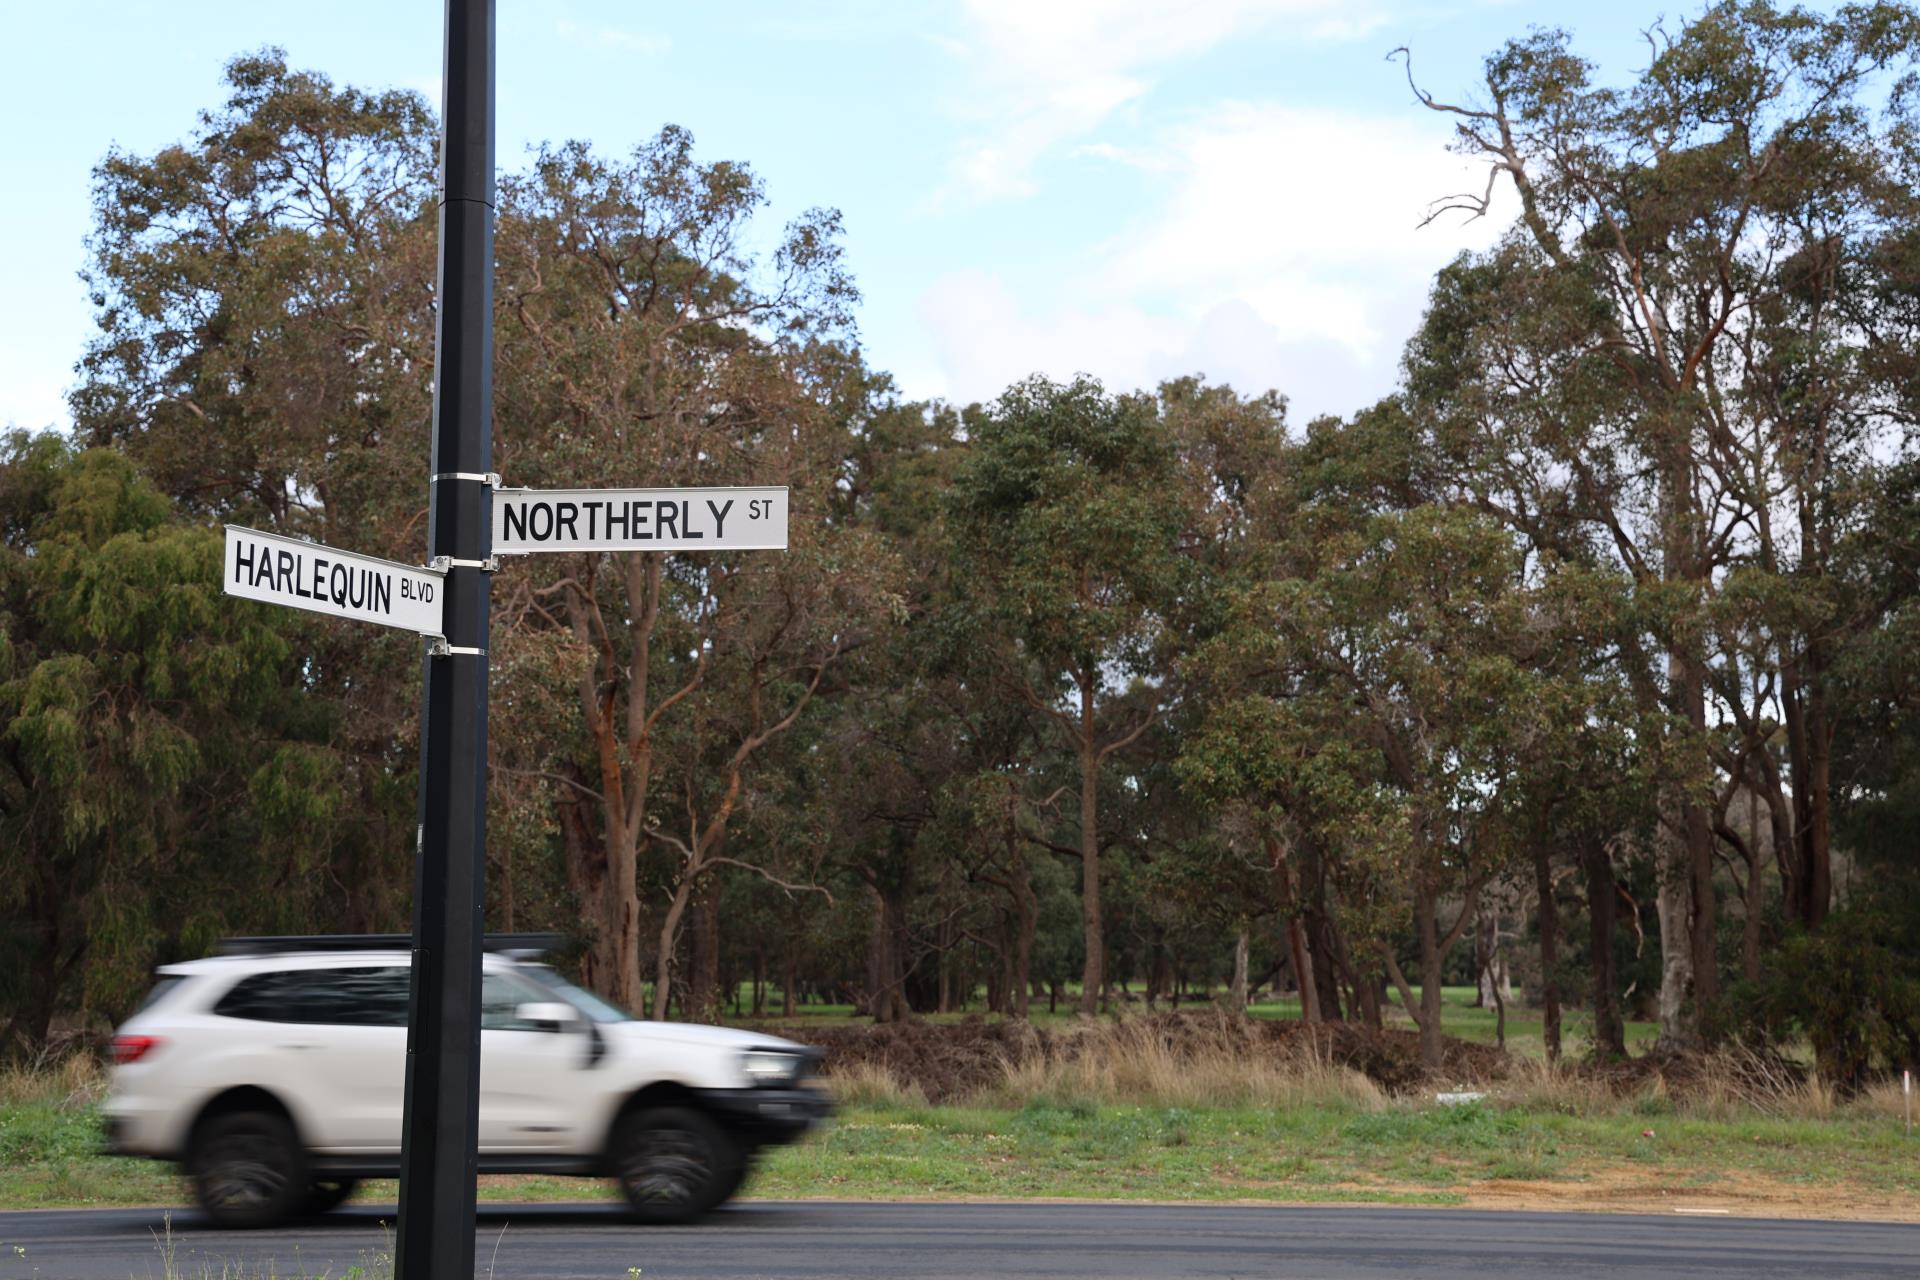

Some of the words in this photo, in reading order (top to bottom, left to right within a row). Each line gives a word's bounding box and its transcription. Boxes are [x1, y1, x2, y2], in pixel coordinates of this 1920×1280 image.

[503, 499, 734, 541] NORTHERLY
[748, 499, 773, 520] ST
[235, 540, 391, 615] HARLEQUIN
[401, 578, 434, 604] BLVD
